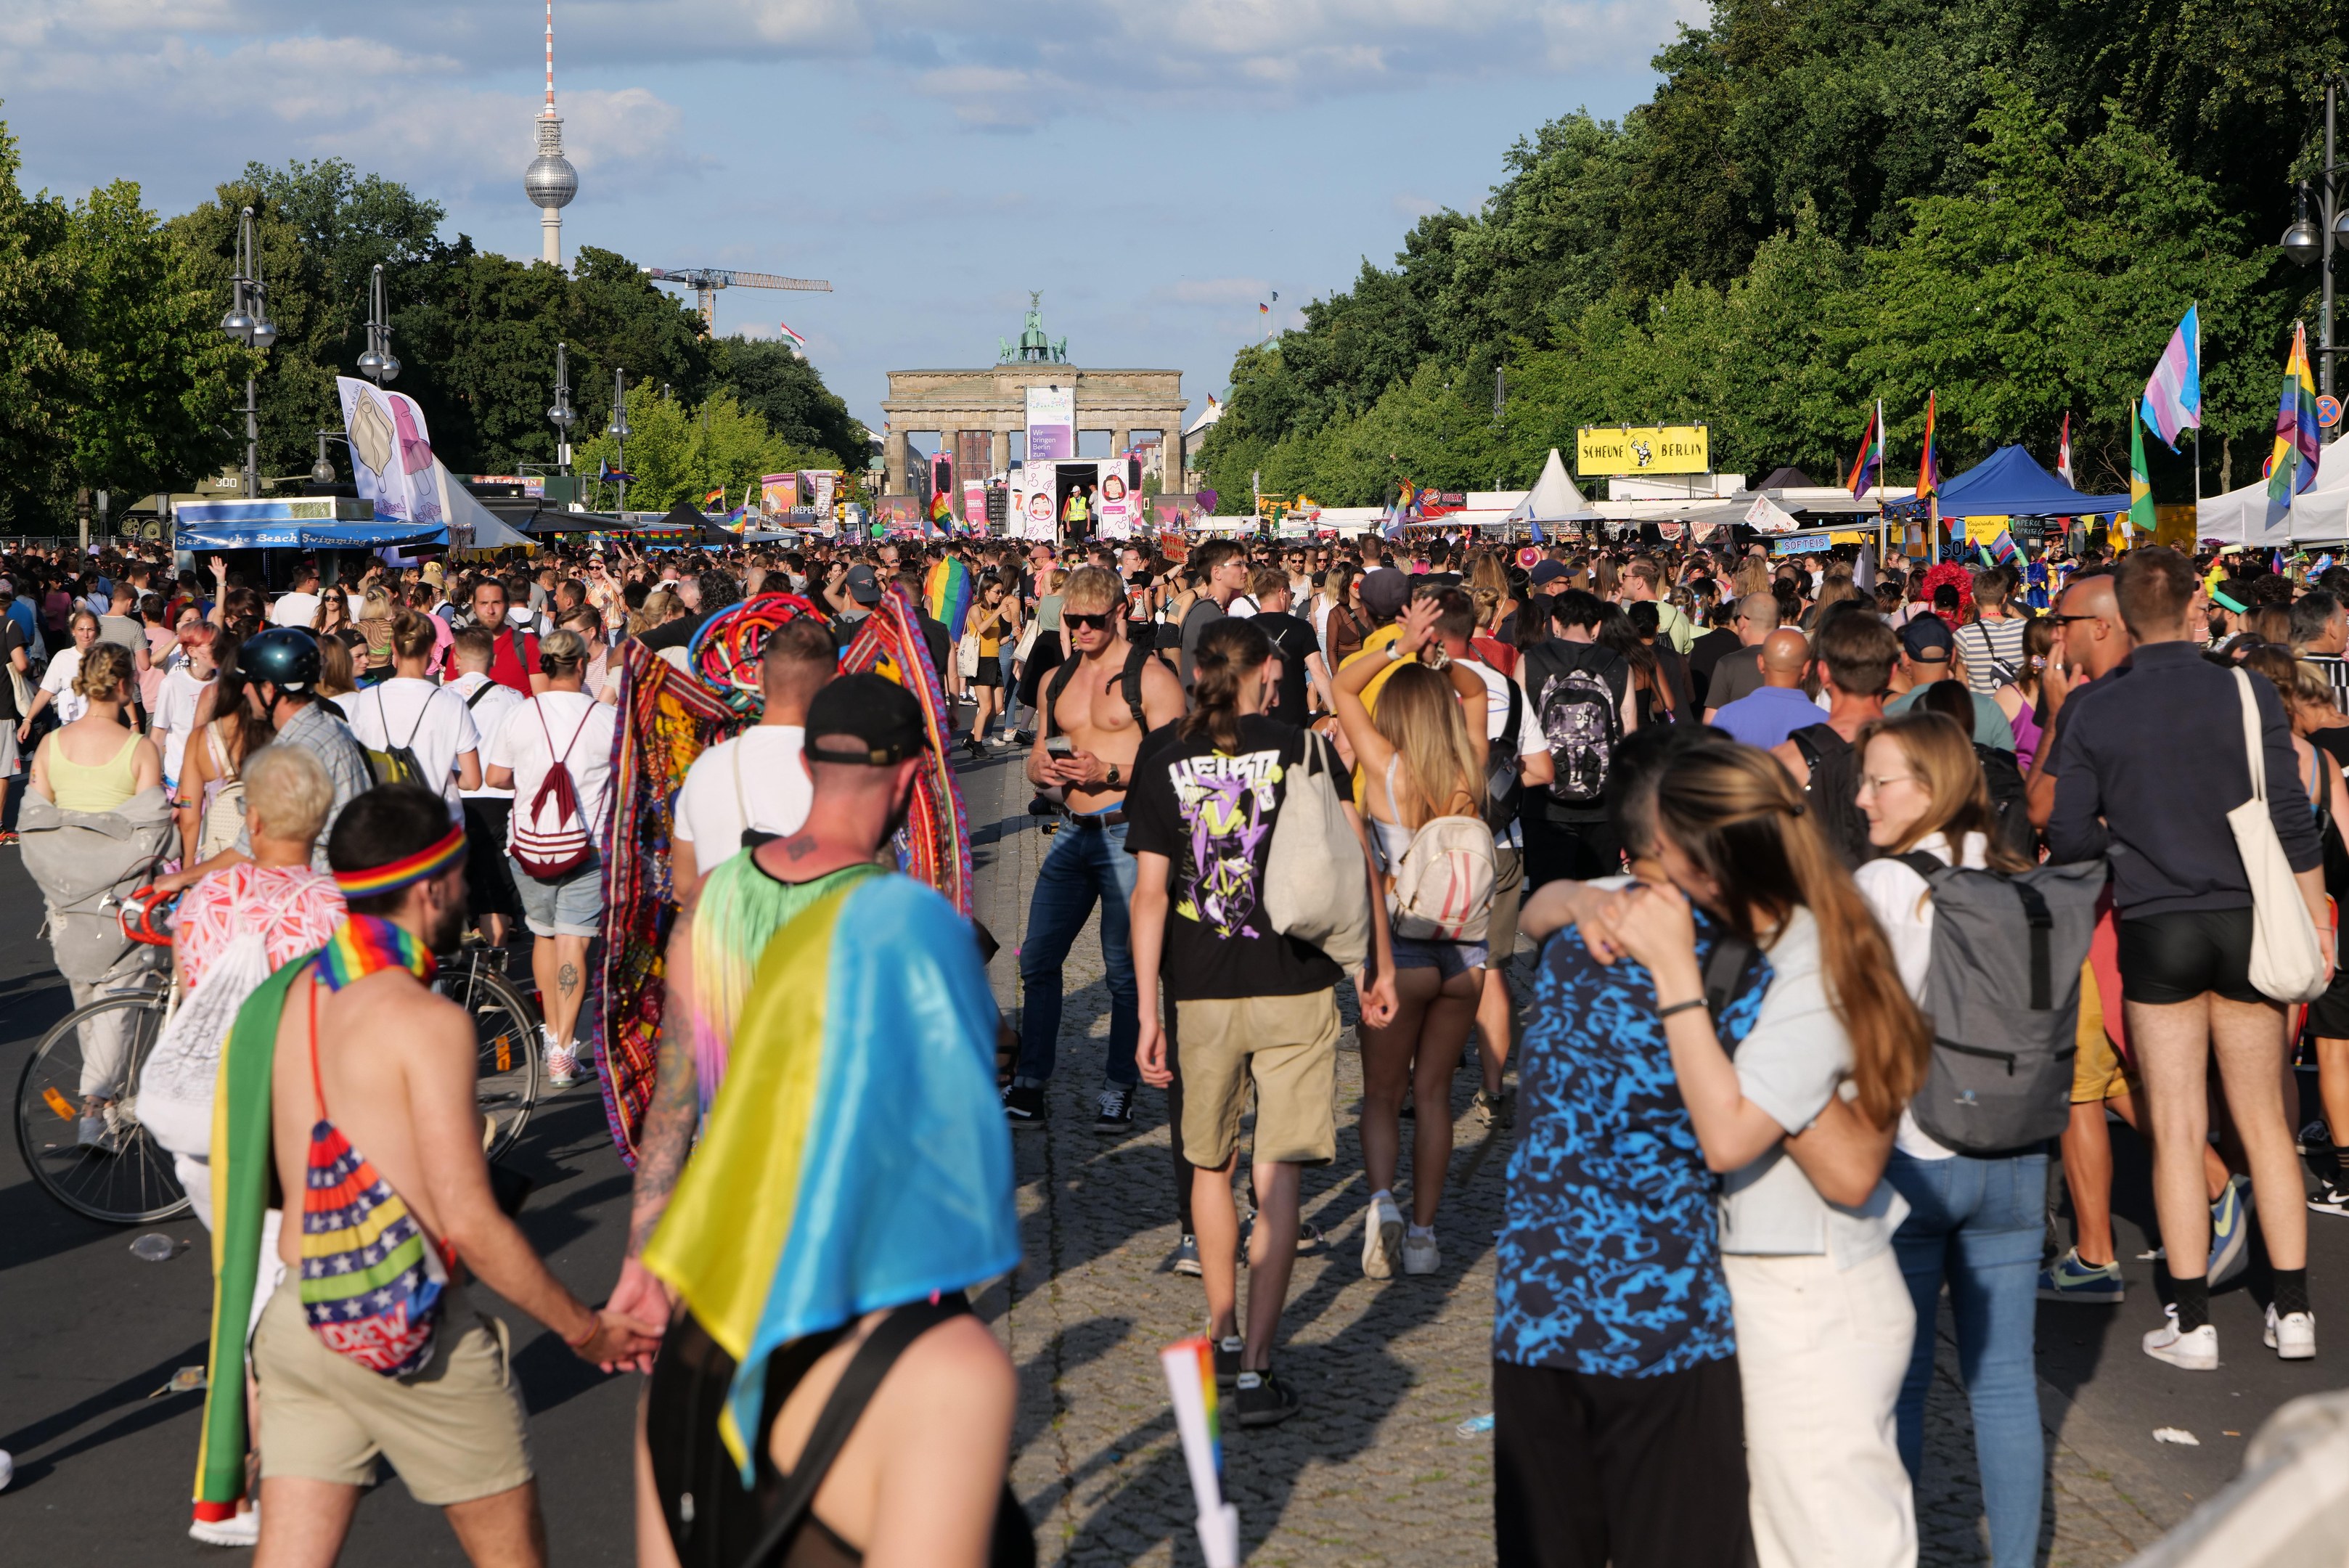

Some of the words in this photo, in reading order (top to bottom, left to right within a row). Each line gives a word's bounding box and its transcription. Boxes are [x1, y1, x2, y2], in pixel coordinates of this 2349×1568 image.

[1583, 445, 1624, 458] SCHEUNE
[1661, 444, 1702, 457] BERLIN
[216, 478, 237, 487] 300
[1442, 493, 1463, 502] STEAK
[177, 536, 201, 545] Sex
[228, 534, 250, 544] the
[256, 533, 298, 544] Beach
[302, 533, 367, 547] Swimming
[372, 536, 395, 544] Pool
[1784, 538, 1825, 551] SOFTEIS
[321, 1300, 408, 1352] DREW
